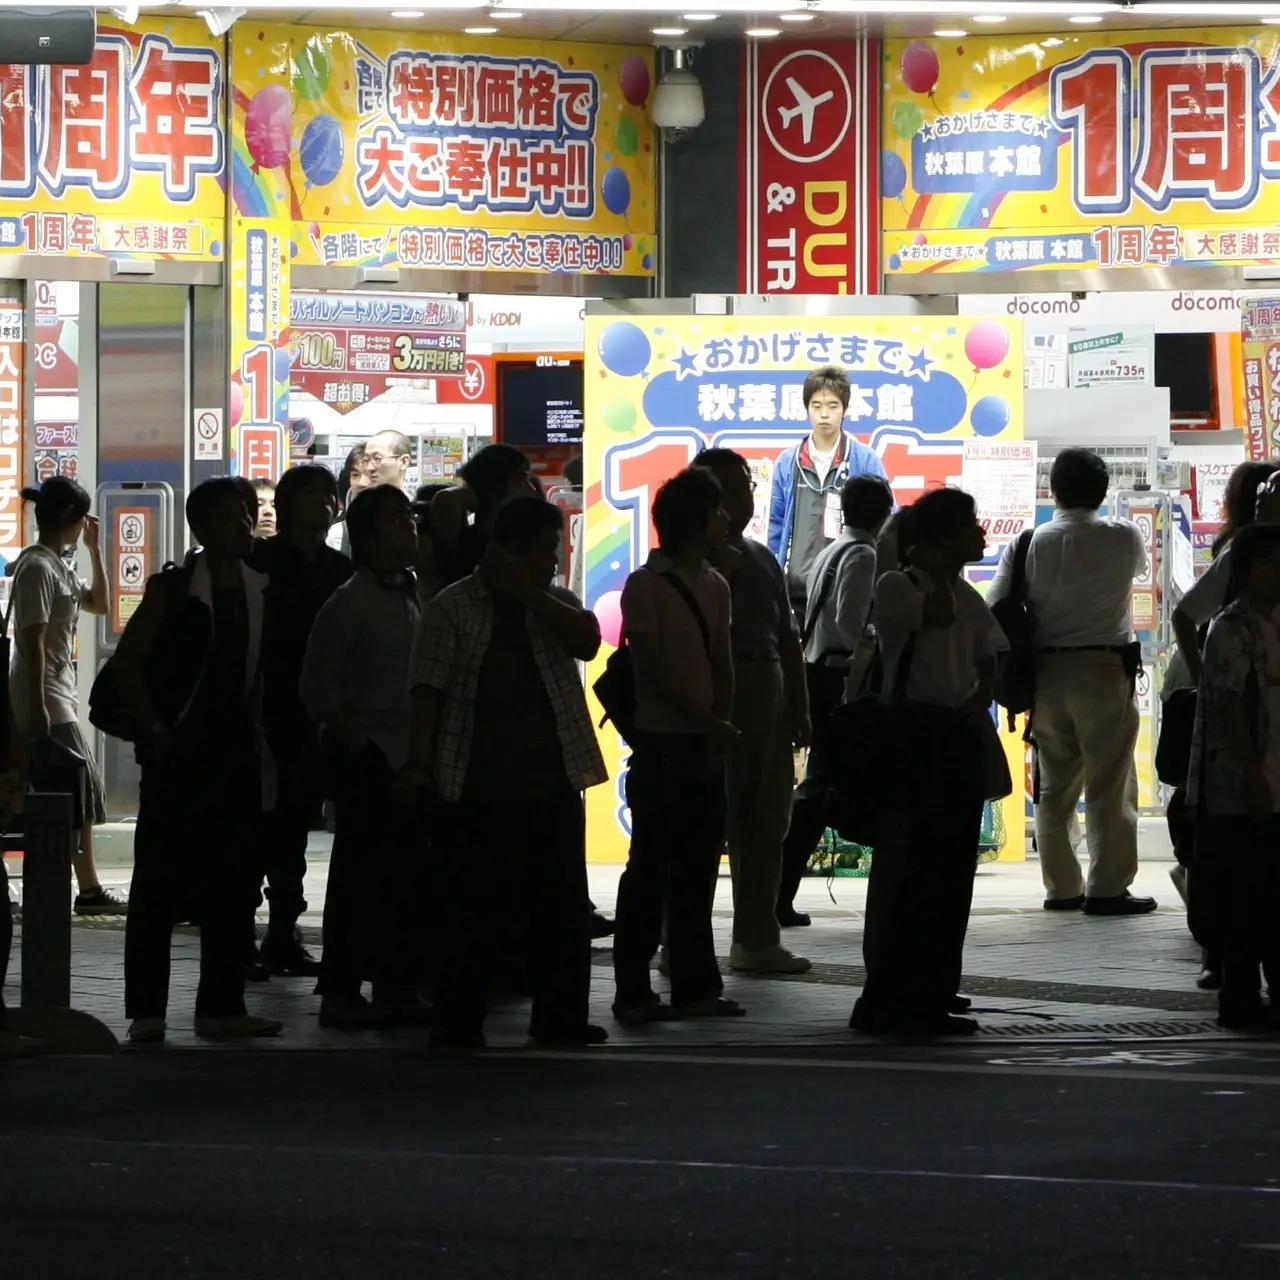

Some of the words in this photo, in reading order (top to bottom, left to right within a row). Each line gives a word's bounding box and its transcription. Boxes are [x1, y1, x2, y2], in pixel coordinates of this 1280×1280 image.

[391, 58, 594, 129] 特別価格で
[925, 151, 984, 176] 秋葉原
[989, 145, 1042, 177] 本館
[21, 213, 96, 252] 1周年
[803, 181, 848, 295] DU
[1093, 227, 1179, 266] 1周年
[1197, 233, 1280, 256] 大感謝祭
[489, 313, 521, 326] KDDI
[1007, 297, 1081, 315] docomo
[705, 334, 904, 369] おかげさまで
